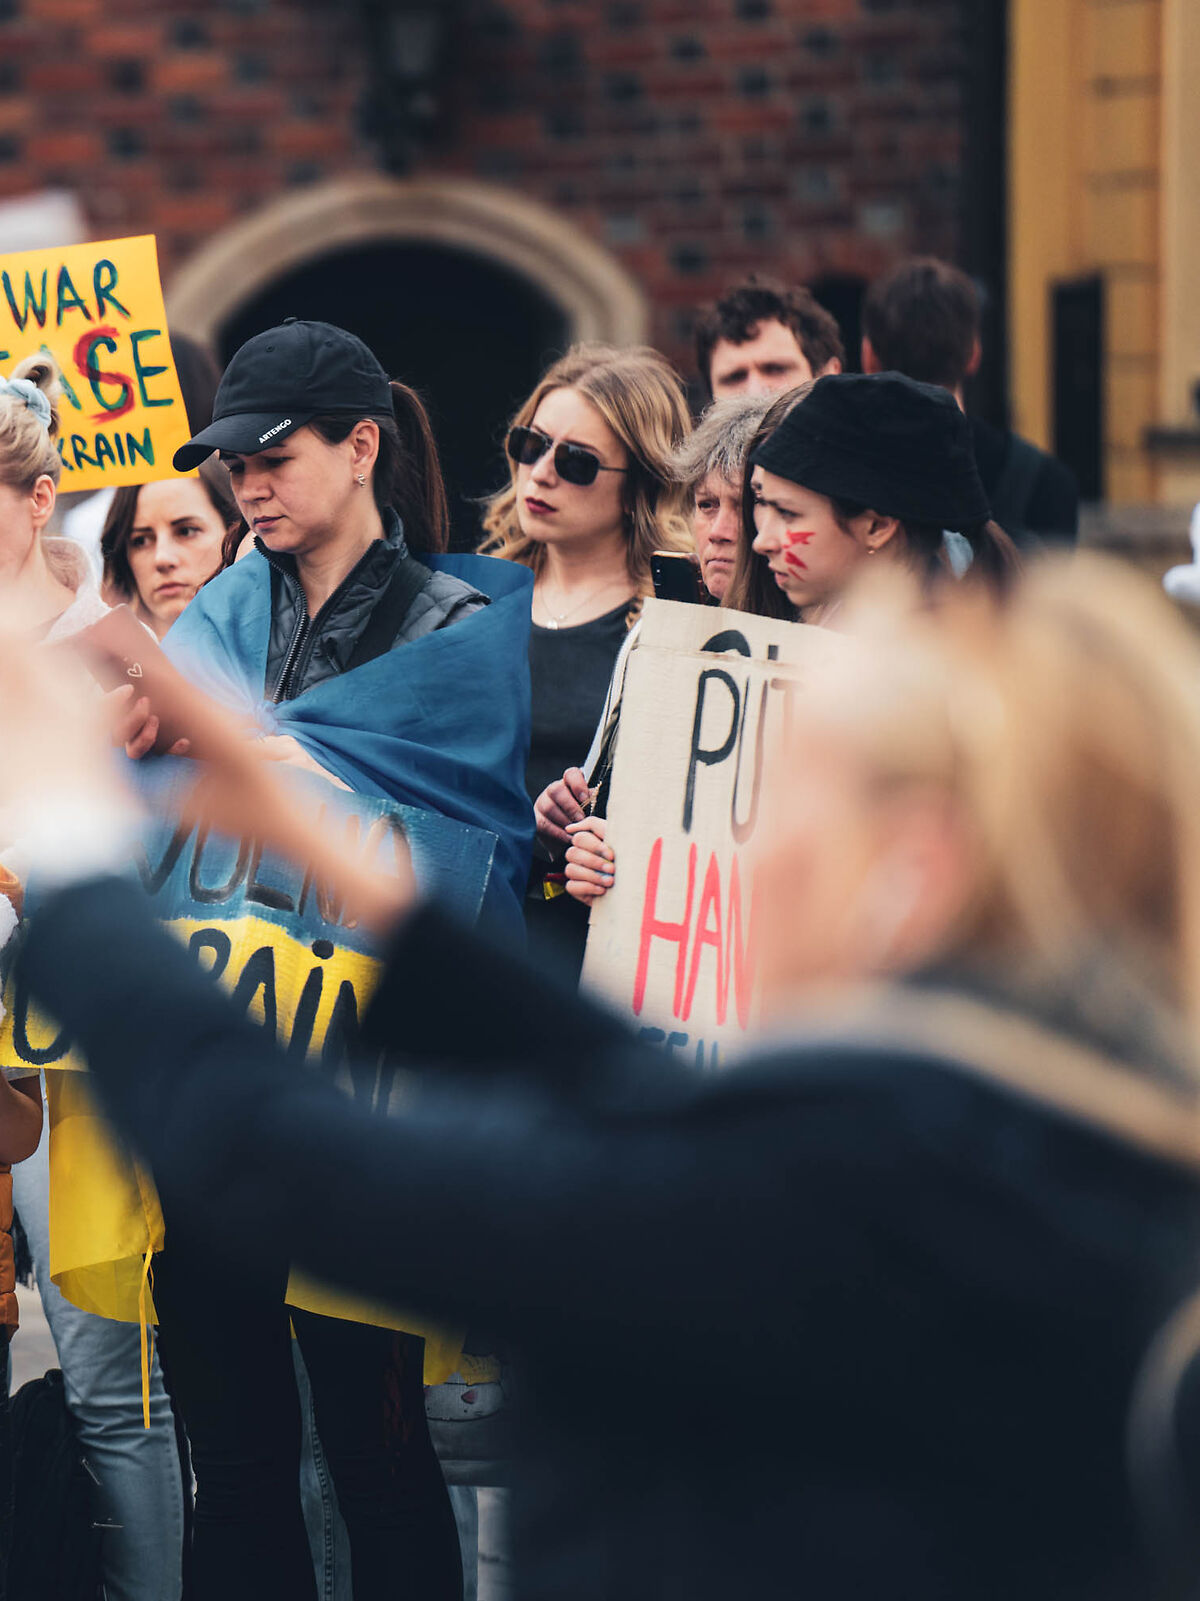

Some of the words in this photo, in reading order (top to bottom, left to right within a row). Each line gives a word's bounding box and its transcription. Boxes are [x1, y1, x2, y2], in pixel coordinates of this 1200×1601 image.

[0, 258, 132, 333] WAR
[56, 427, 155, 472] KRAIN
[258, 418, 292, 444] ARTENGO
[632, 836, 762, 1031] HAN
